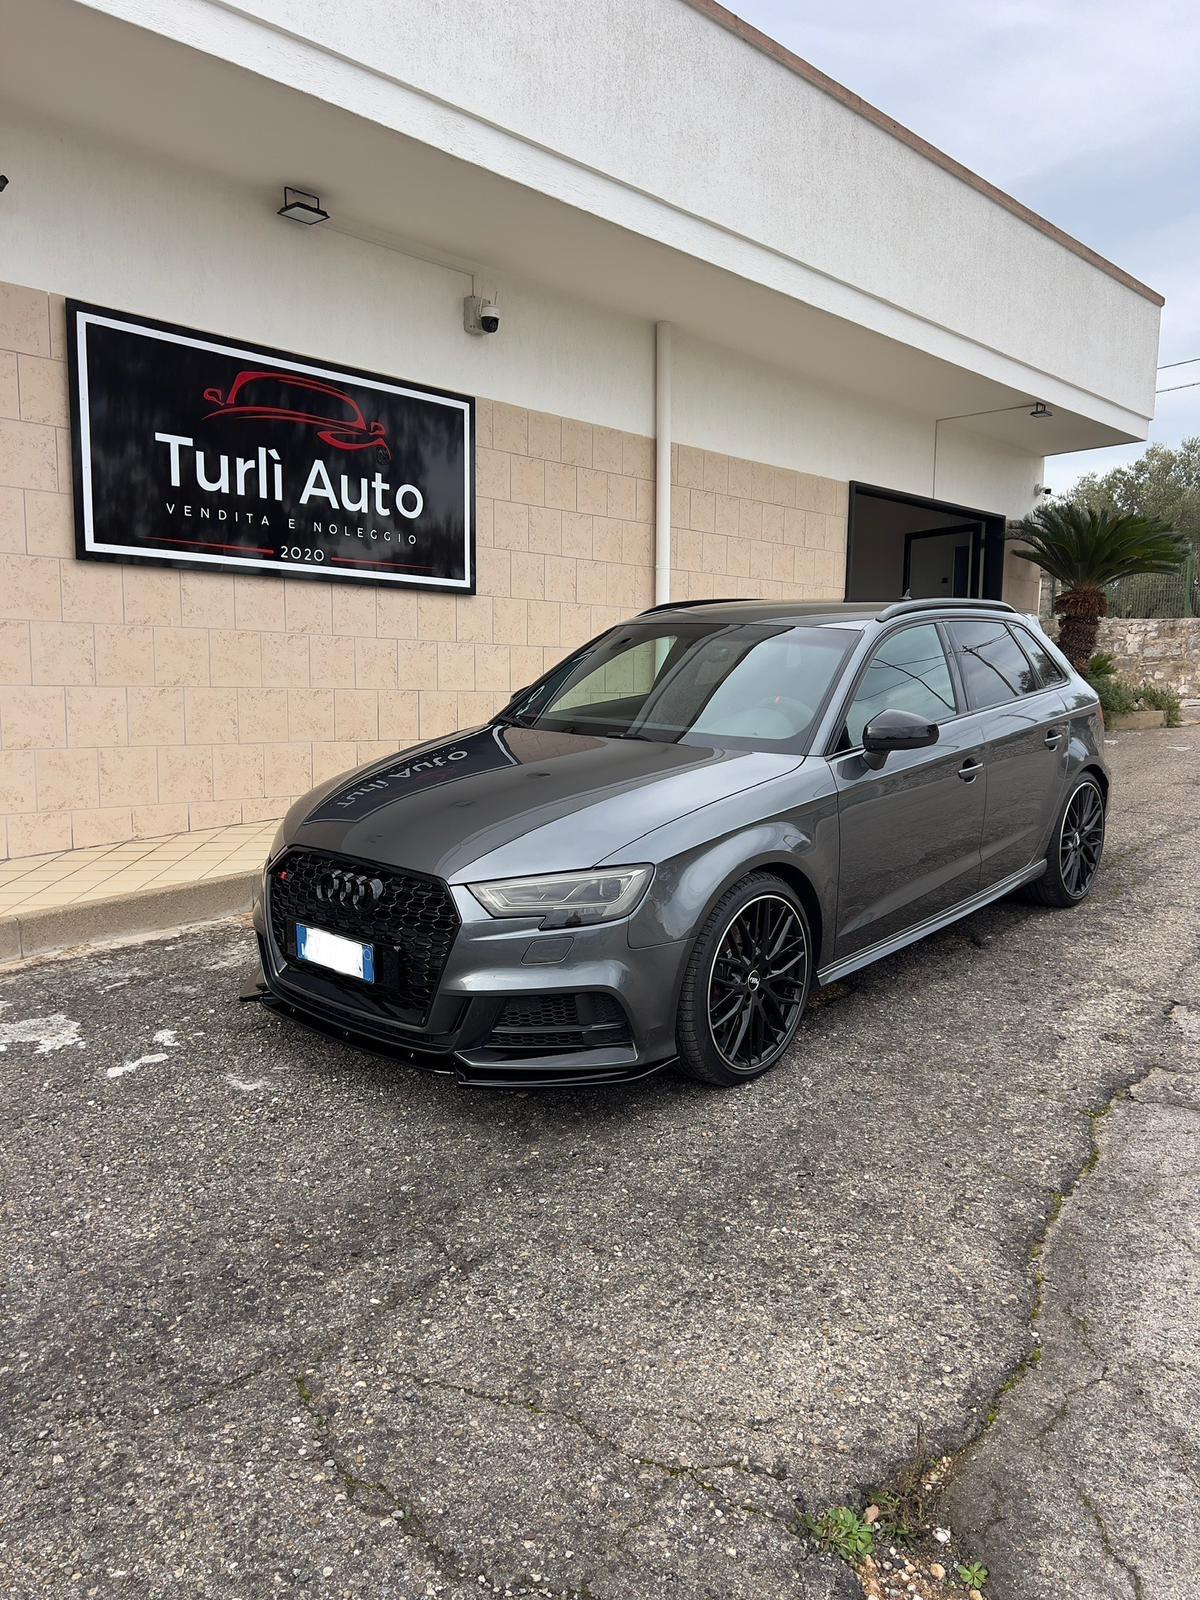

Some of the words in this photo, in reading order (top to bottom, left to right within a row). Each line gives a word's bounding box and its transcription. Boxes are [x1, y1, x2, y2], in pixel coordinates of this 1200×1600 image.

[154, 432, 284, 501] Turlì
[299, 459, 424, 520] Auto
[166, 503, 270, 526] VENDITA
[288, 518, 296, 529] E
[313, 522, 417, 545] NOLEGGIO
[280, 546, 325, 562] 2020
